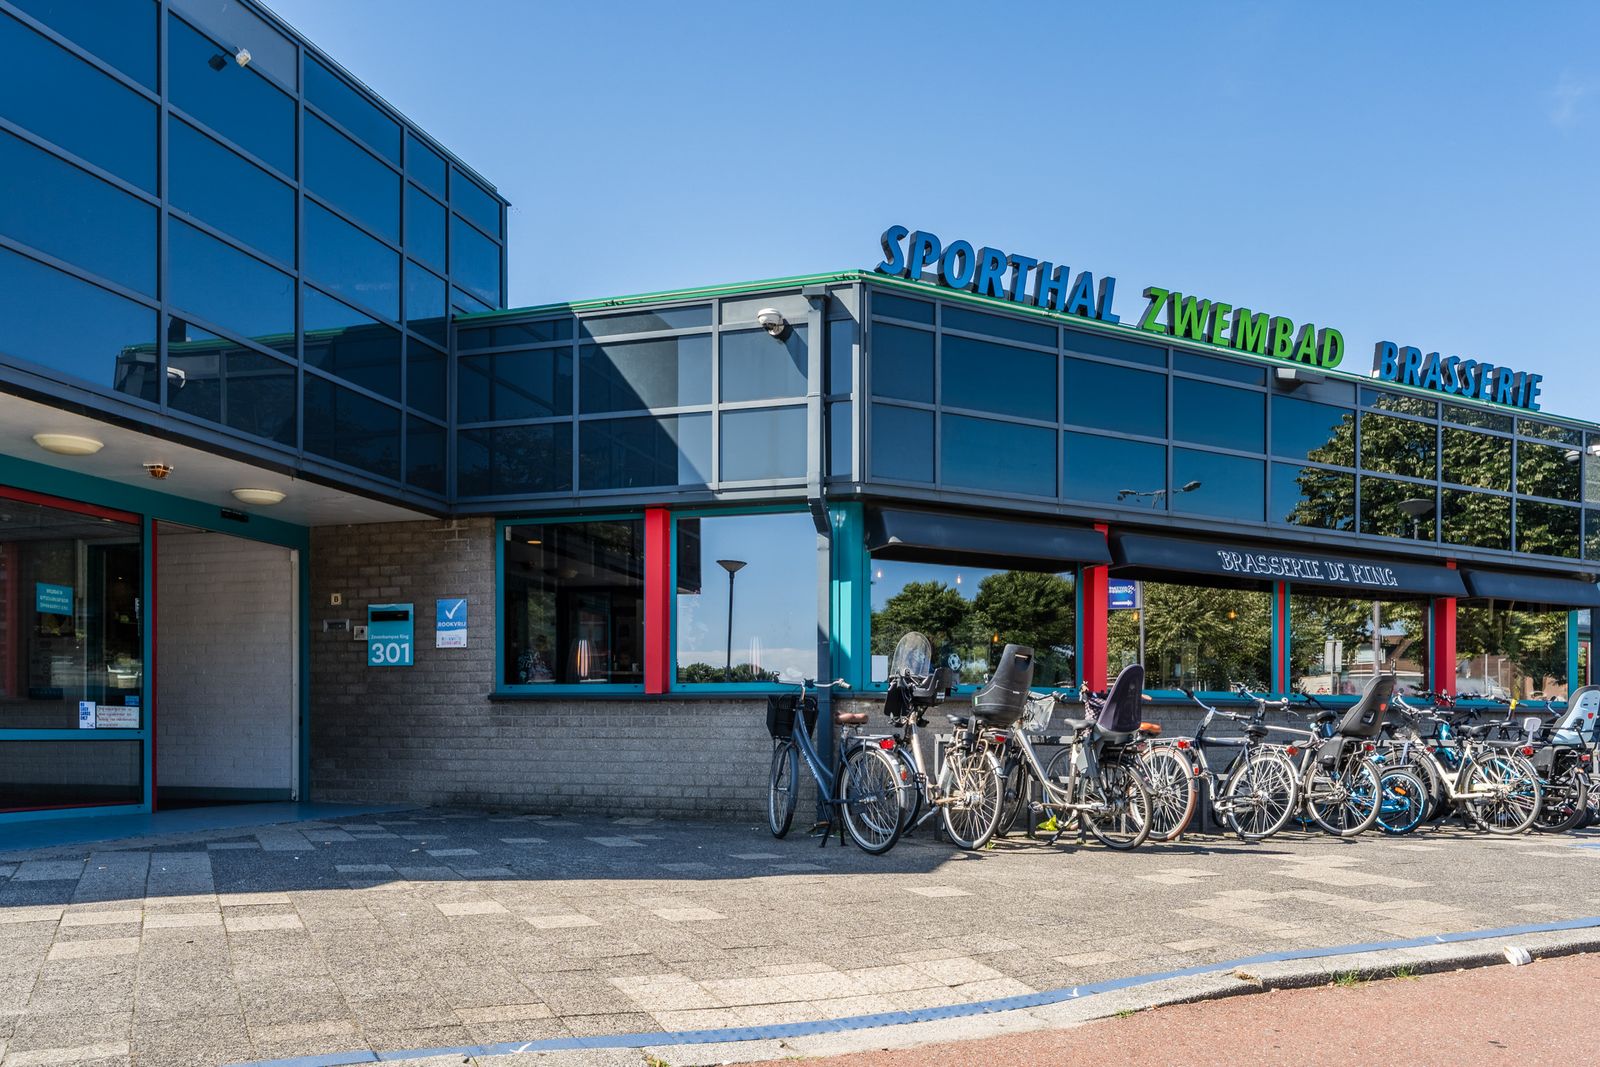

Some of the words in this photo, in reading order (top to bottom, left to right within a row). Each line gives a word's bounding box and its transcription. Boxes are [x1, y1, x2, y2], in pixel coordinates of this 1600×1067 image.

[874, 225, 1120, 324] SPORTHAL
[1136, 286, 1345, 369] ZWEMBAD
[1372, 341, 1543, 411] BRASSERIE
[1217, 550, 1324, 580] BRASSERIE
[1324, 561, 1350, 582] DE
[1350, 563, 1399, 586] RING
[371, 642, 410, 664] 301
